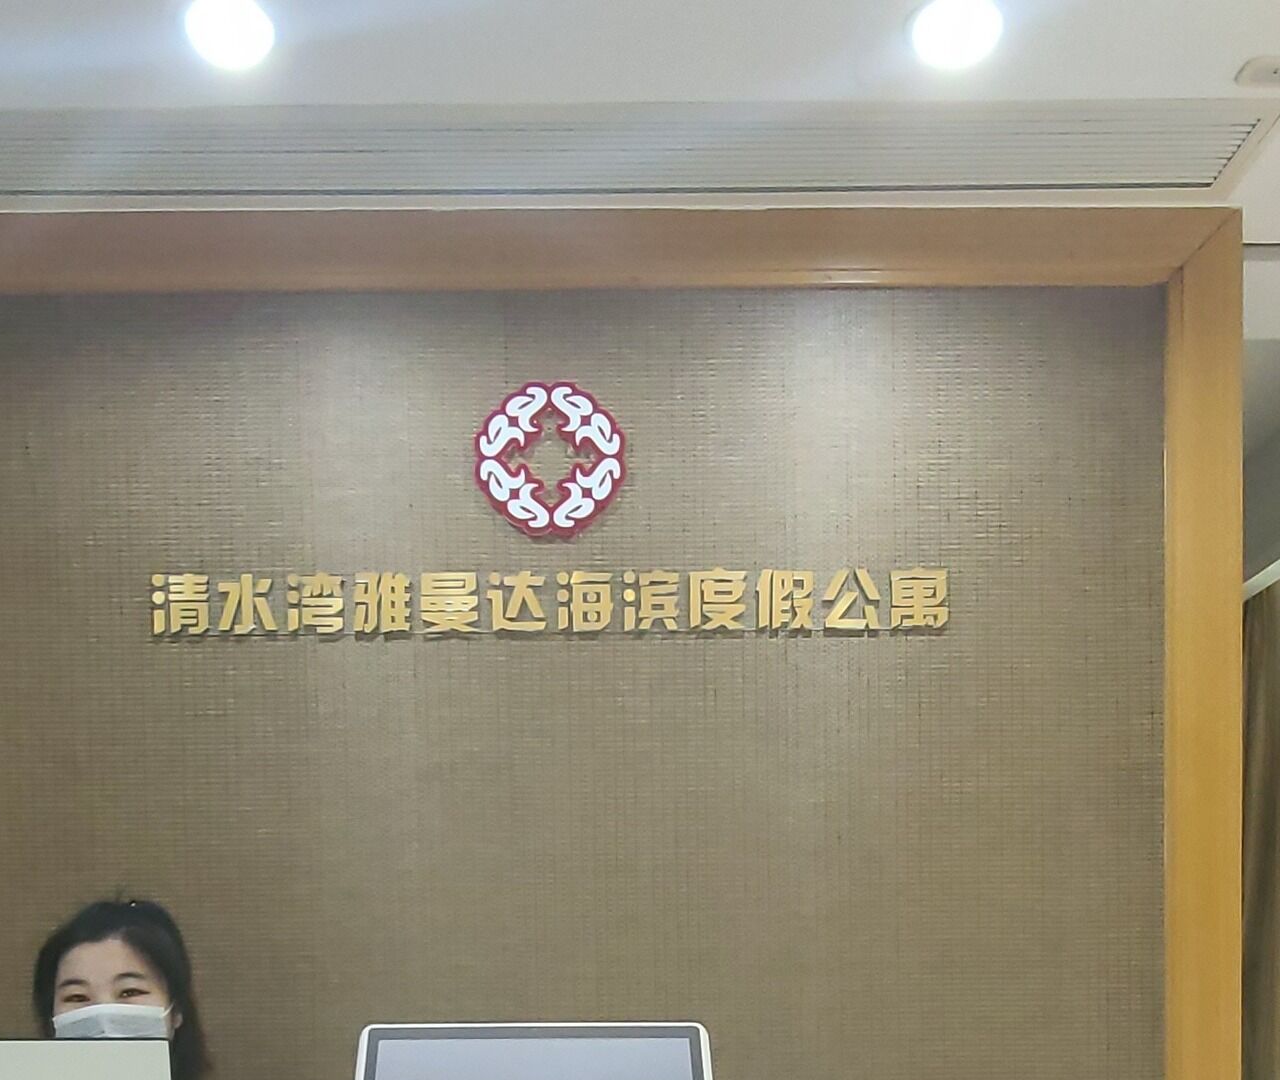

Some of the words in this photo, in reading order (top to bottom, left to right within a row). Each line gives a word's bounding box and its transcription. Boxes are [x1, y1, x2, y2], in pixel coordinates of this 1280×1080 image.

[149, 566, 950, 637] 清水湾雅曼达海滨度假公寓
